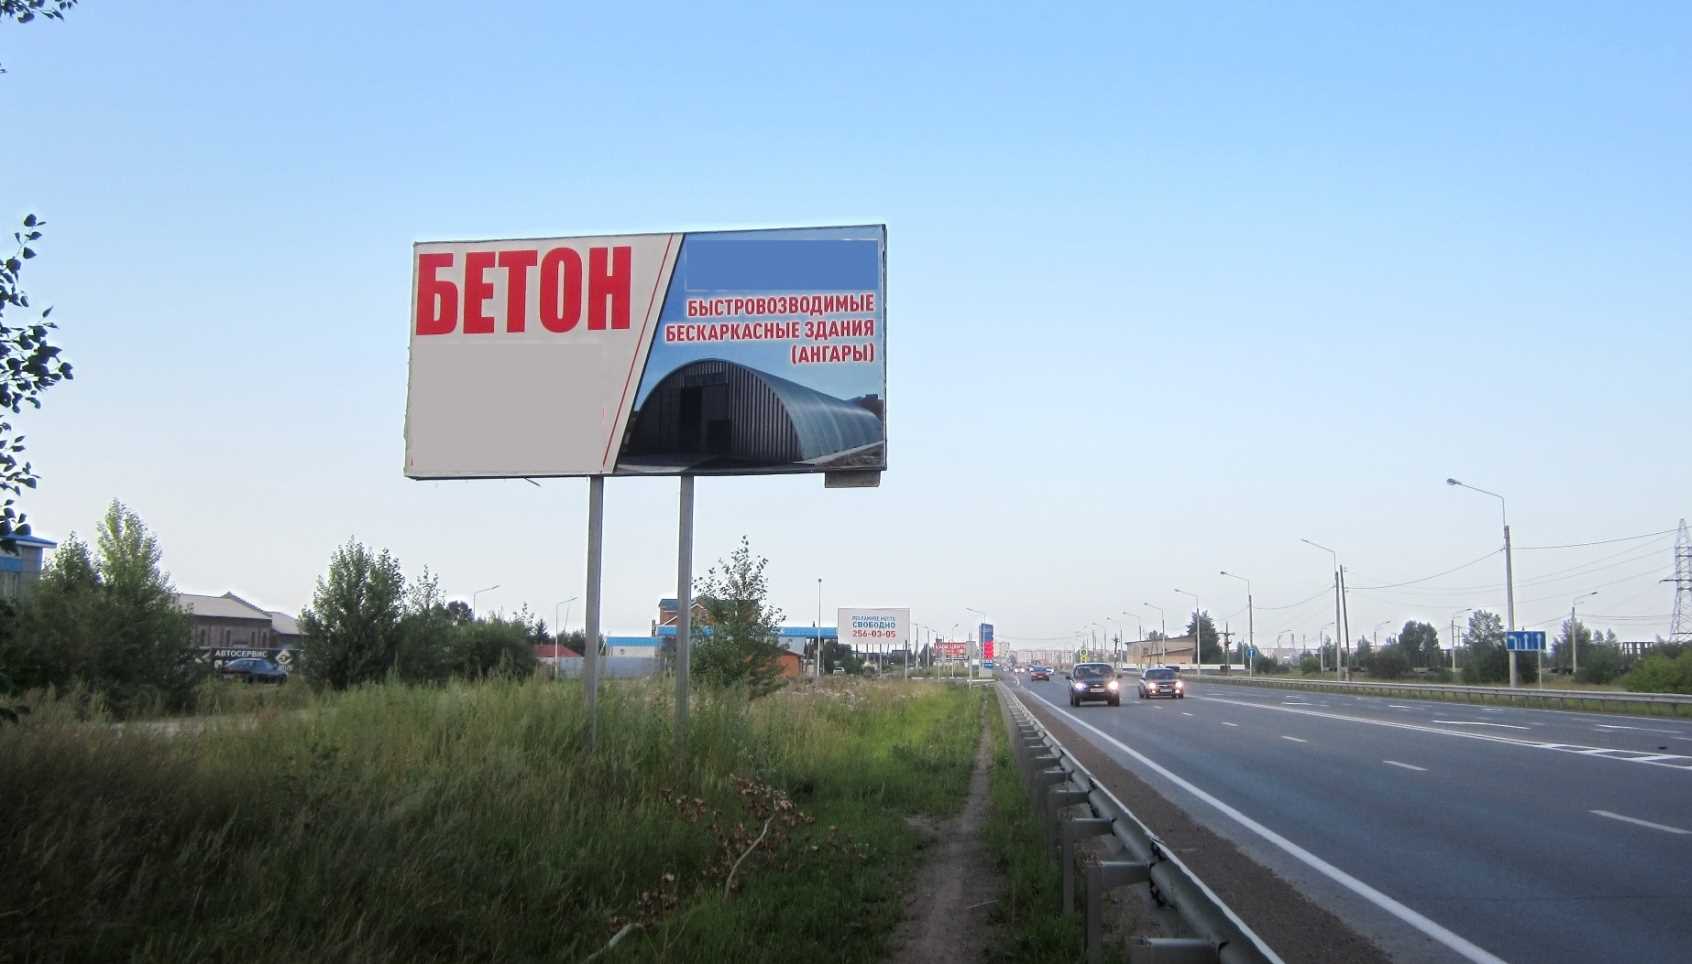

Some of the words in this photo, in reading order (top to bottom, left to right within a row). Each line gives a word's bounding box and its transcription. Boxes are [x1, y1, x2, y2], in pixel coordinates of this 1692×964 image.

[415, 246, 632, 336] БЕТОН
[687, 293, 875, 318] БЫСТРОВОЗВОДИМЫЕ
[665, 322, 801, 343] БЕСКАРКАСНЫЕ
[804, 319, 875, 339] ЗДАНИЯ
[791, 343, 875, 364] (АНГАРЫ)
[852, 621, 896, 629] СВОБОДНО
[852, 630, 896, 638] 256-03-05
[214, 649, 268, 658] АВТОСЕРВИС
